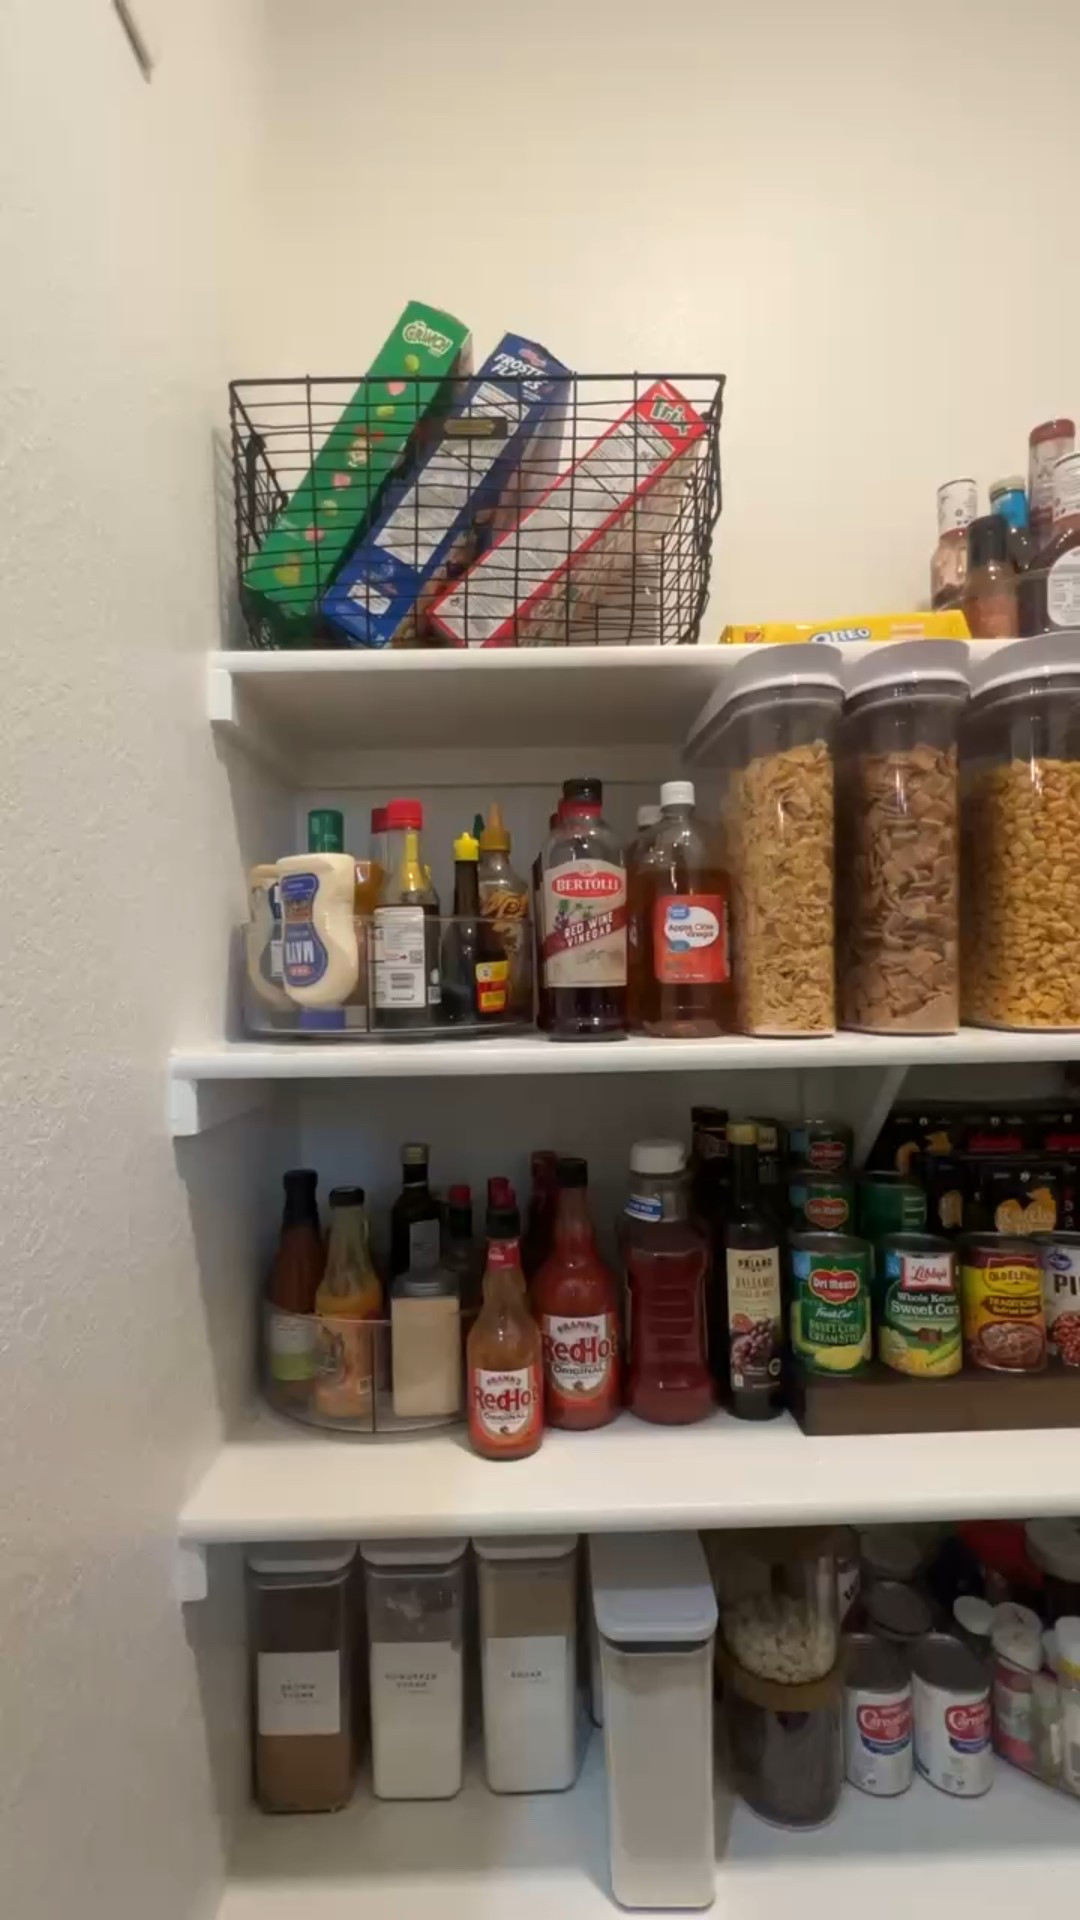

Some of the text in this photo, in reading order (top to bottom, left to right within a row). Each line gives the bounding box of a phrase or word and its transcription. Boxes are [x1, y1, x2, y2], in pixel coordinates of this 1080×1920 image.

[652, 395, 690, 434] Trix
[811, 629, 870, 642] OREO
[556, 879, 618, 891] BERTOLLI
[564, 911, 613, 938] RED WINE
[567, 924, 612, 947] VINEGAR
[1053, 1274, 1080, 1296] PI
[890, 1300, 934, 1316] Sweet
[541, 1334, 617, 1364] RedHot
[473, 1386, 538, 1411] RedHot
